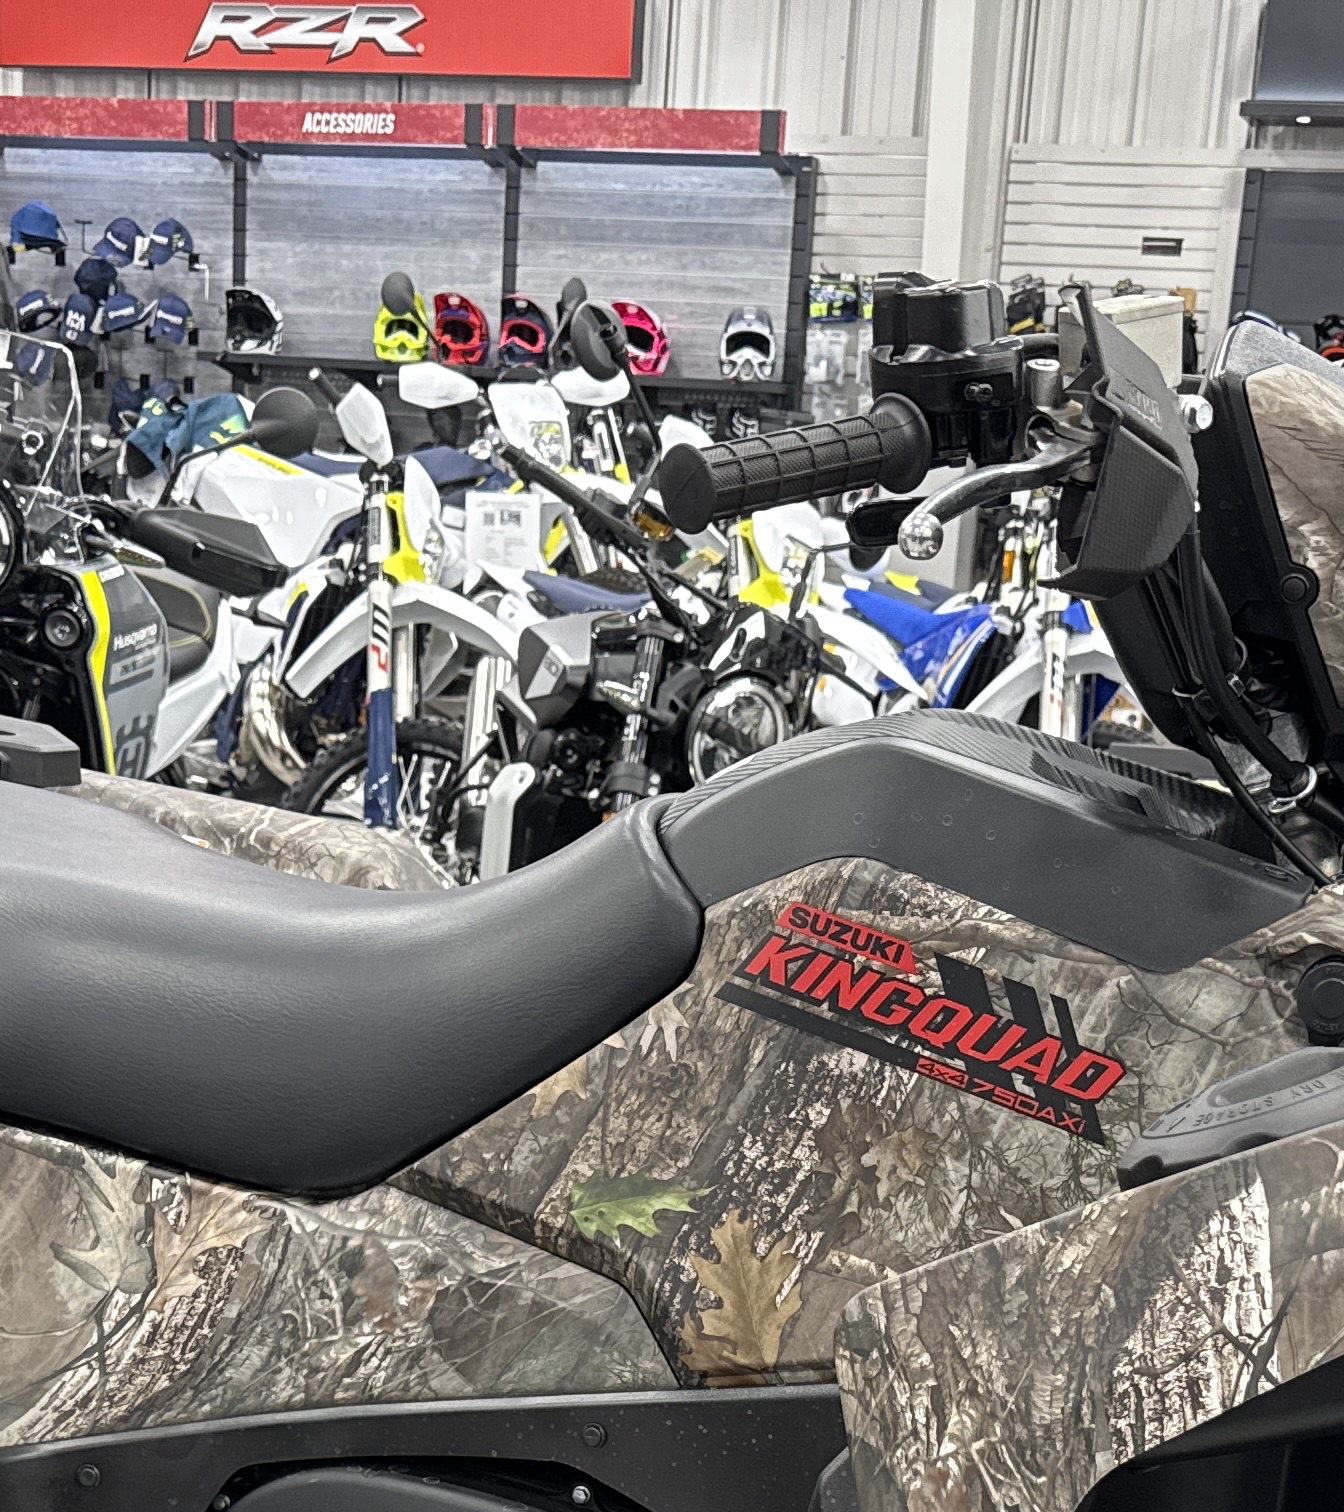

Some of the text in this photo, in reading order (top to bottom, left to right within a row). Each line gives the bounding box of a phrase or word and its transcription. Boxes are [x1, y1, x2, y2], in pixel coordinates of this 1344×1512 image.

[184, 2, 427, 64] RZR
[302, 111, 396, 135] ACCESSORIES
[788, 905, 906, 964] SUZUKI
[742, 934, 1128, 1101] KINGQUAD
[917, 1059, 1087, 1134] 4x4 750AXi
[1192, 1095, 1275, 1128] STORAGE
[1290, 1079, 1327, 1098] DRY
